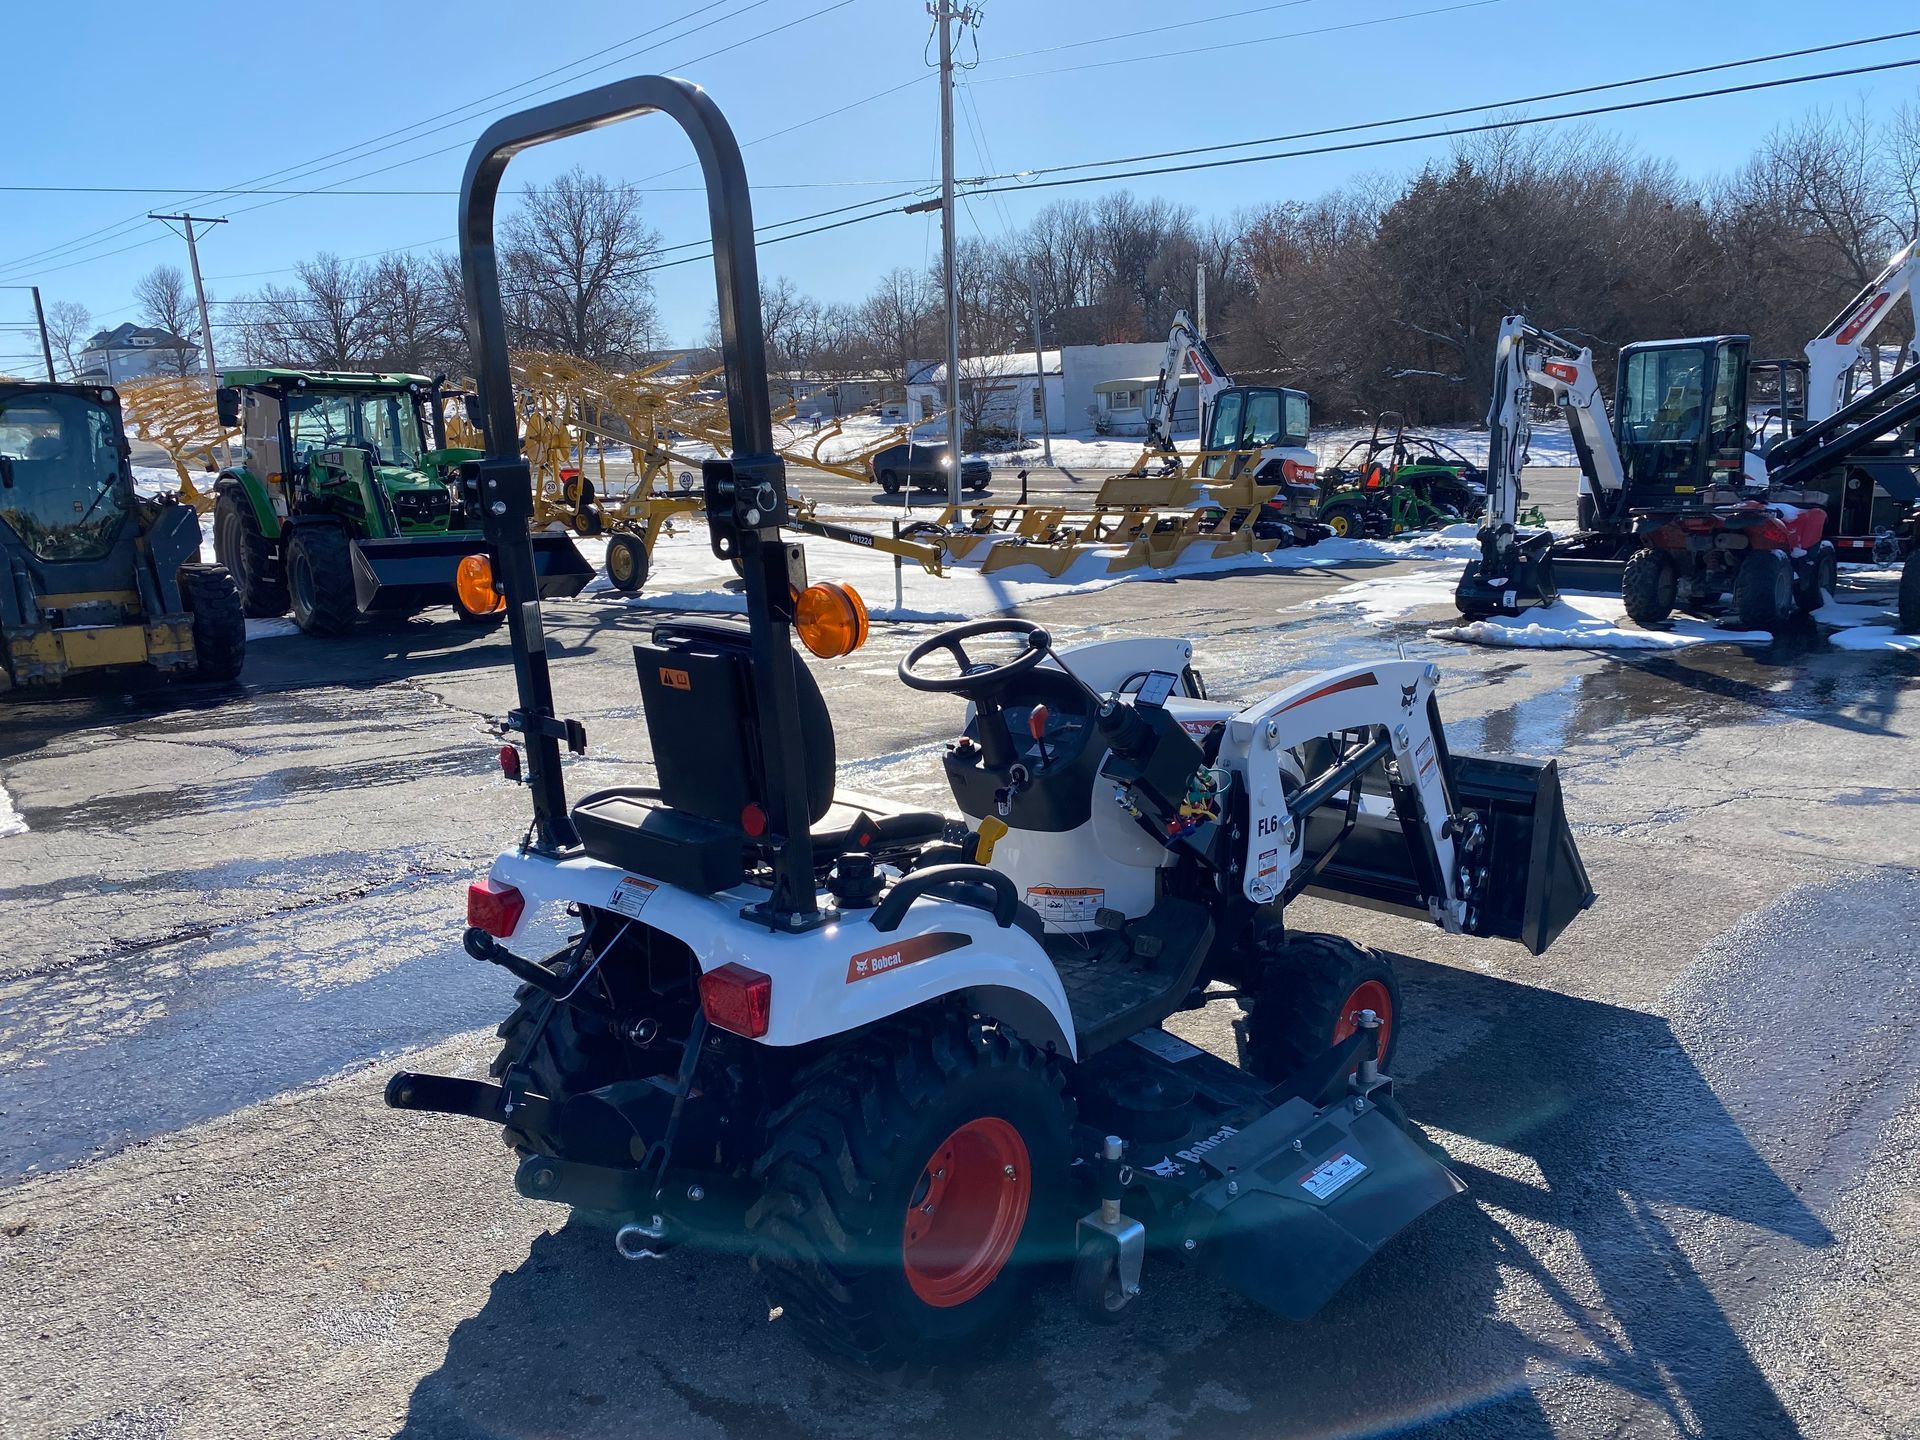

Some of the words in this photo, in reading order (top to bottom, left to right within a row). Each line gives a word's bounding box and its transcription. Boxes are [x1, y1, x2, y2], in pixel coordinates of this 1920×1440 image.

[849, 533, 873, 546] VR1224
[1258, 815, 1278, 837] FL6
[871, 951, 902, 971] Bobcat
